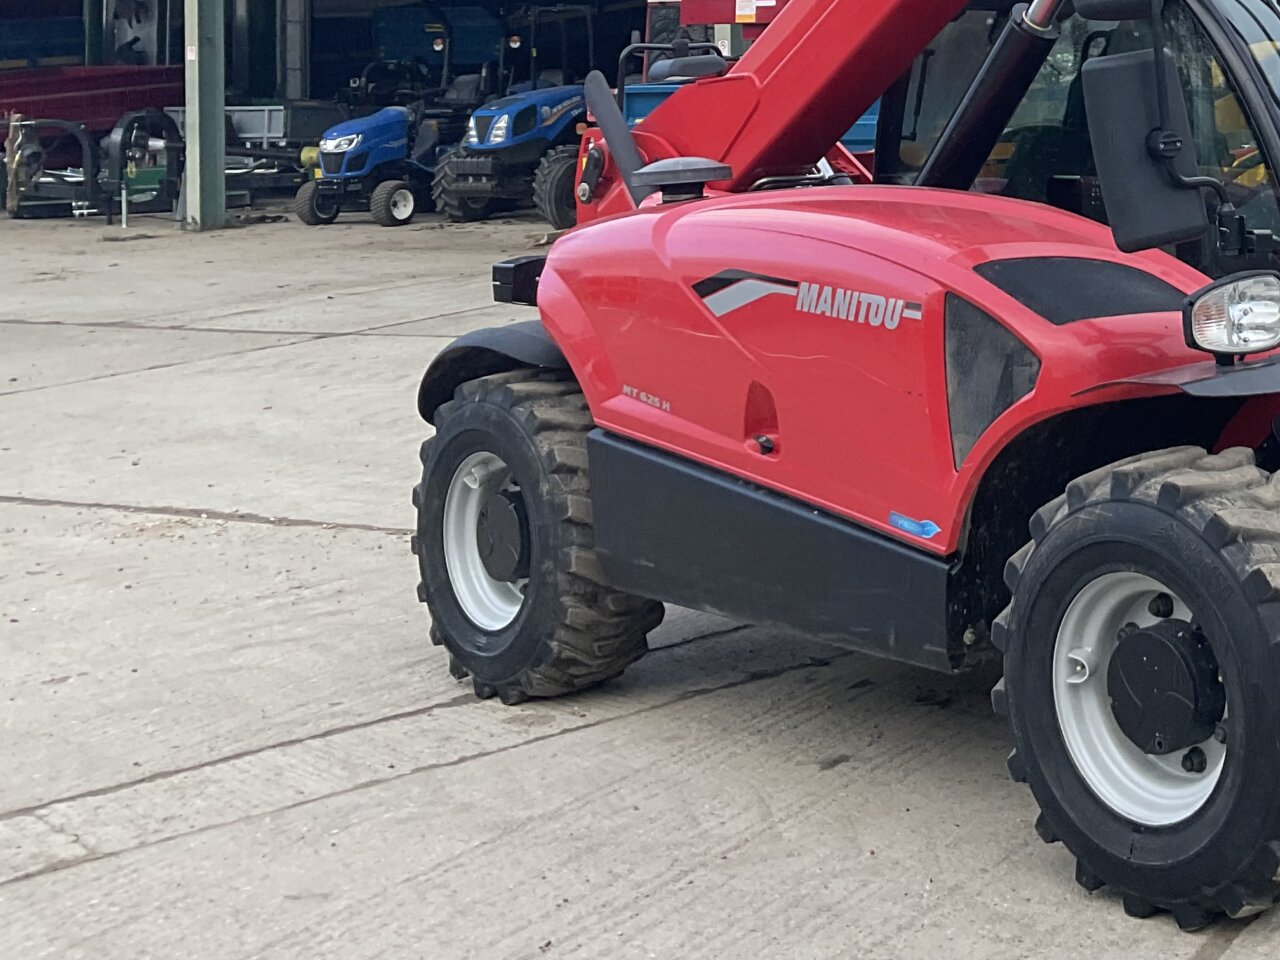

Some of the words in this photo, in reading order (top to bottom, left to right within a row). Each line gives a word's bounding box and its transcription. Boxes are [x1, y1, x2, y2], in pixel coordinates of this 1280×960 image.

[796, 281, 904, 329] MANITOU
[622, 383, 639, 398] MT
[662, 400, 671, 413] H
